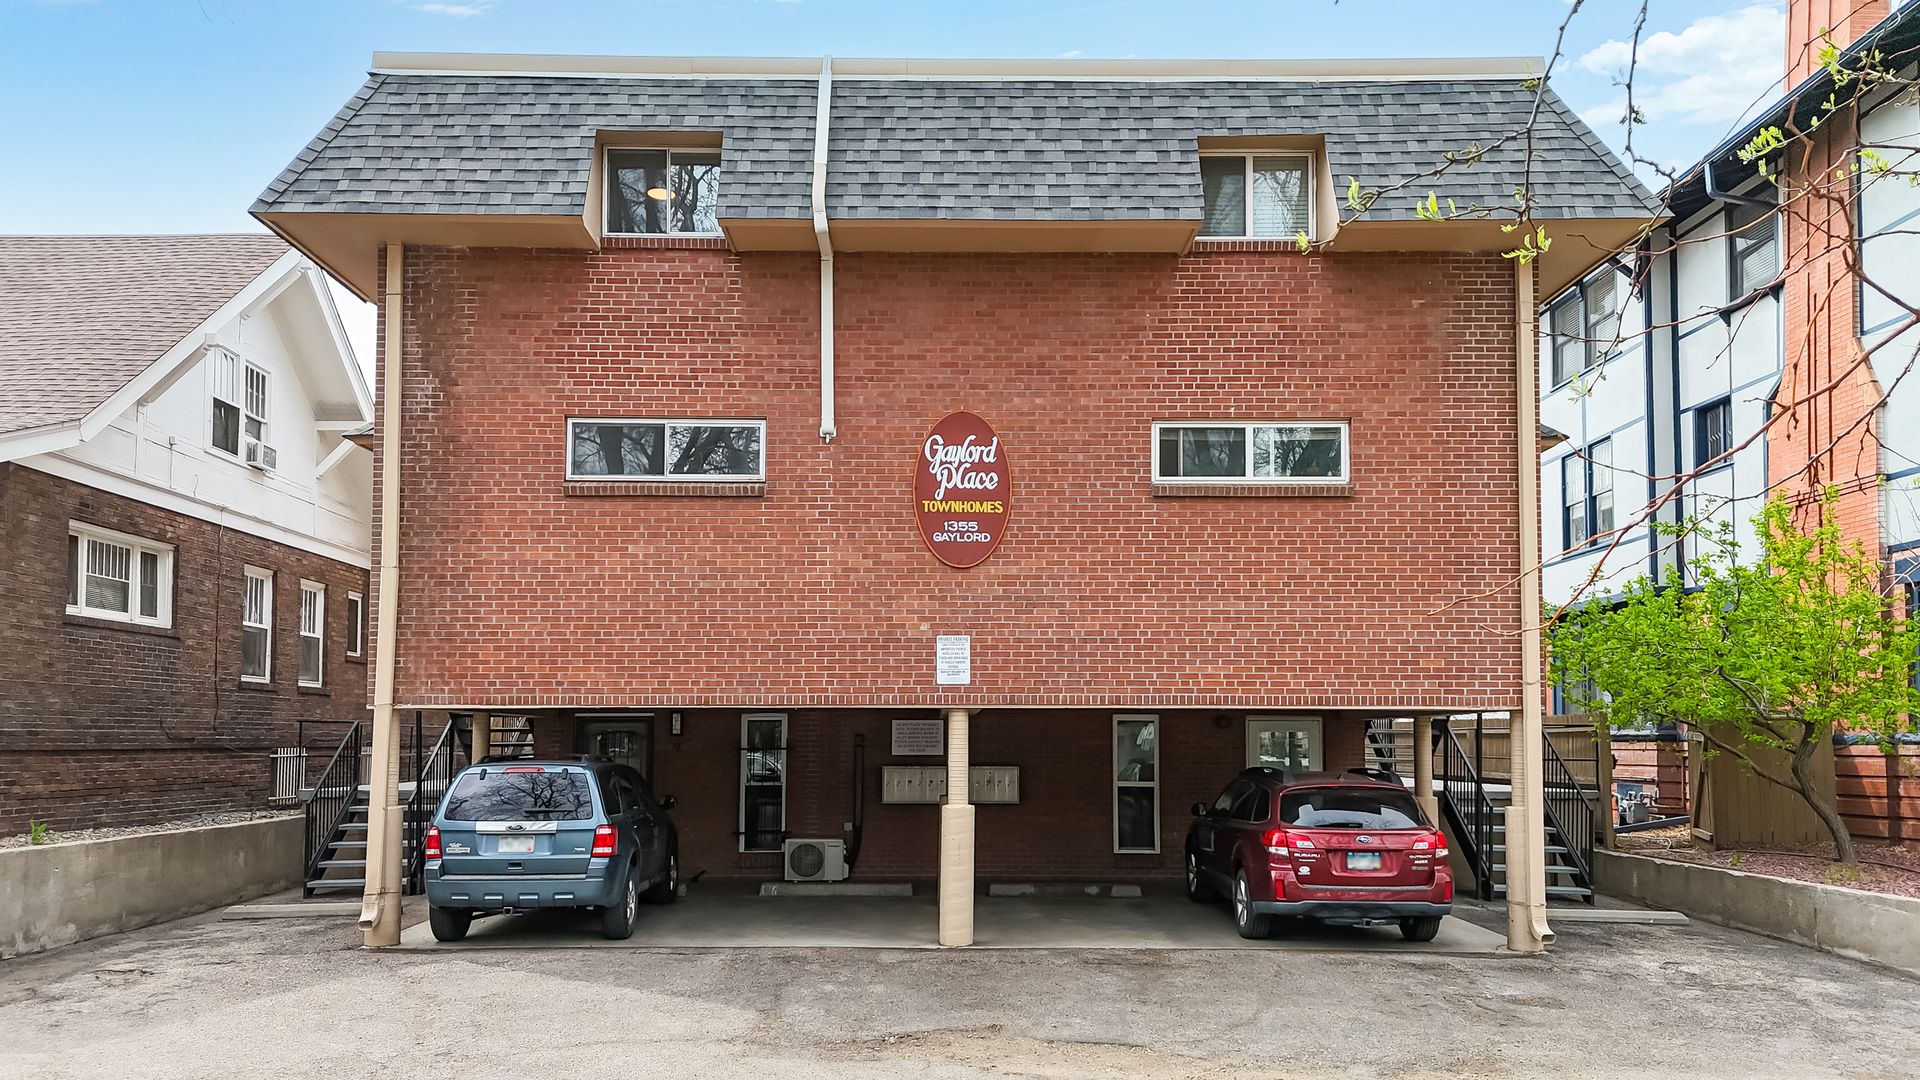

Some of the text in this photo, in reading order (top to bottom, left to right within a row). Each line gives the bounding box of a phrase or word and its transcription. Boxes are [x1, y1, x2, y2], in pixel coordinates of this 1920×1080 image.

[924, 434, 998, 474] Gaylord
[934, 463, 998, 500] Place
[922, 500, 1003, 513] TOWNHOMES
[943, 521, 978, 531] 1355
[933, 532, 990, 542] GAYLORD
